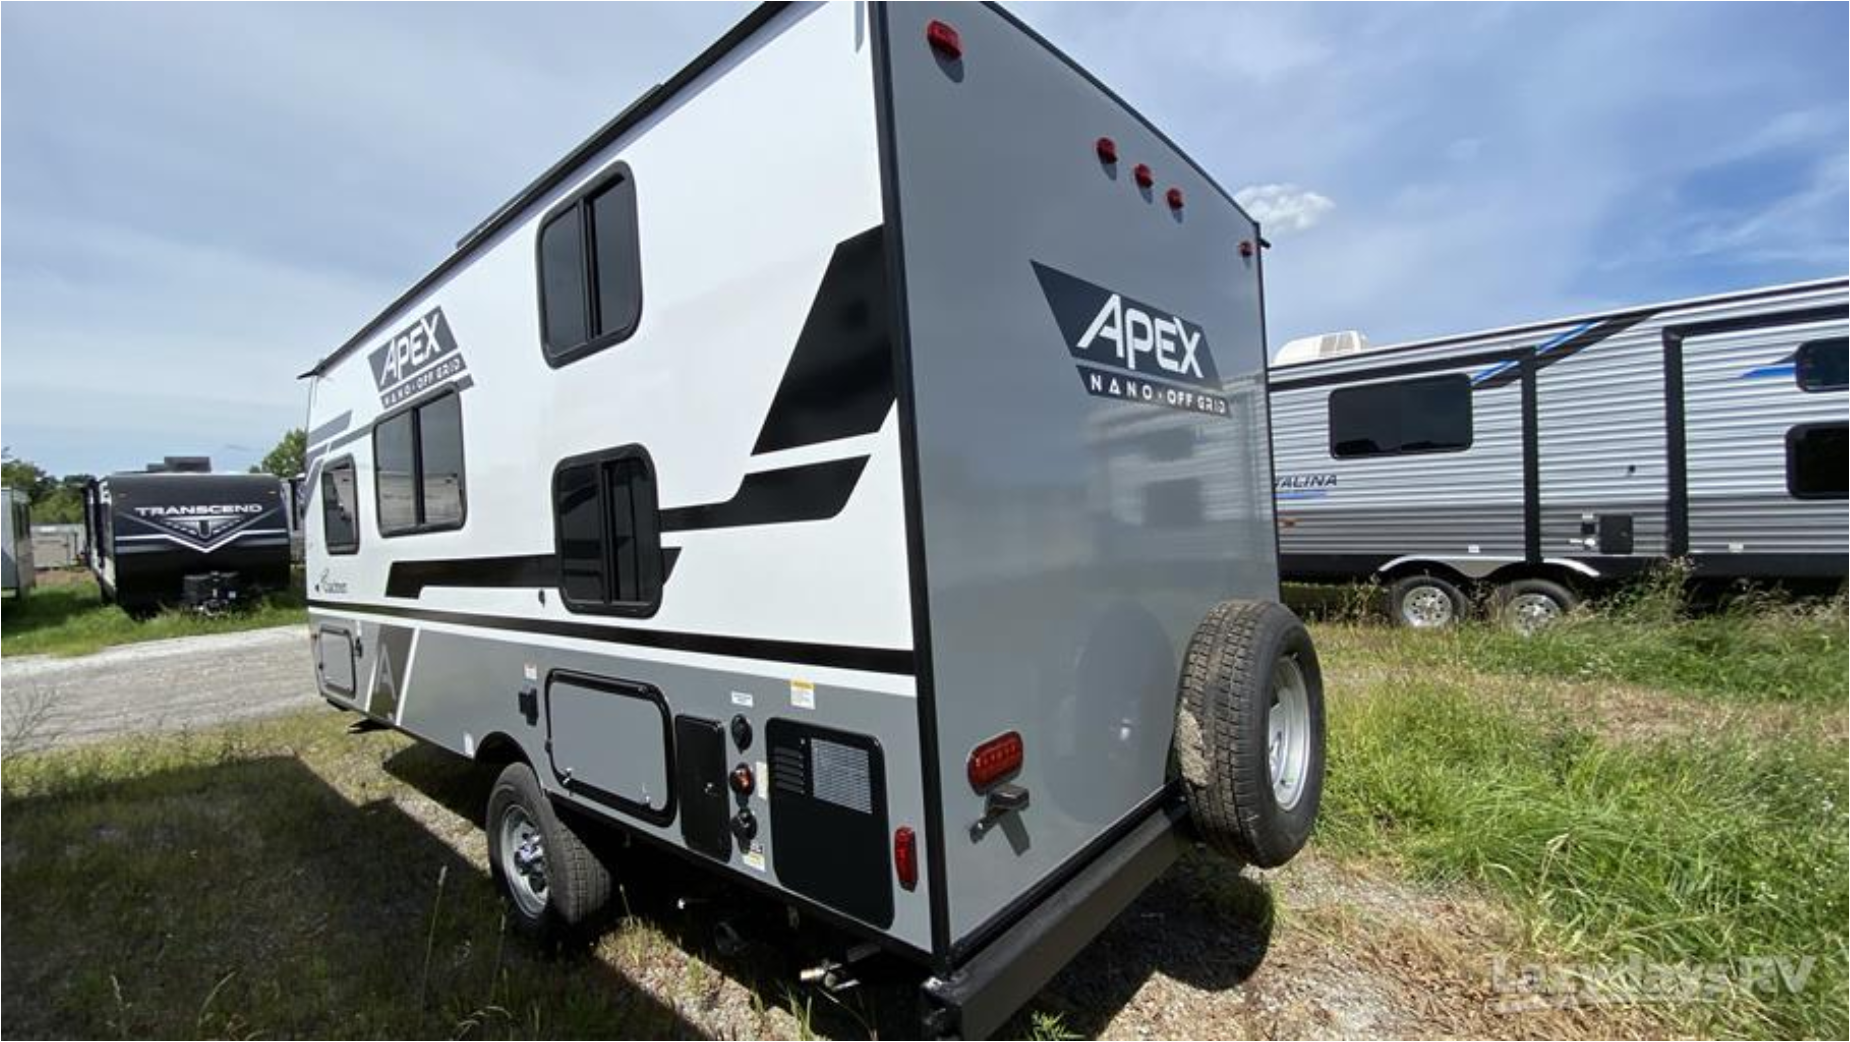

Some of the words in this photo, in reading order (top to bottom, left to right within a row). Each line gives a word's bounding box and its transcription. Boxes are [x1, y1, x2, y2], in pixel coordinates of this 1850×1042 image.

[380, 313, 441, 386] APEX
[1076, 293, 1204, 379] APEX
[1090, 373, 1153, 400] NANO
[1167, 389, 1193, 408] OFF
[1197, 395, 1226, 414] GRID
[134, 503, 263, 516] TRANSCEND
